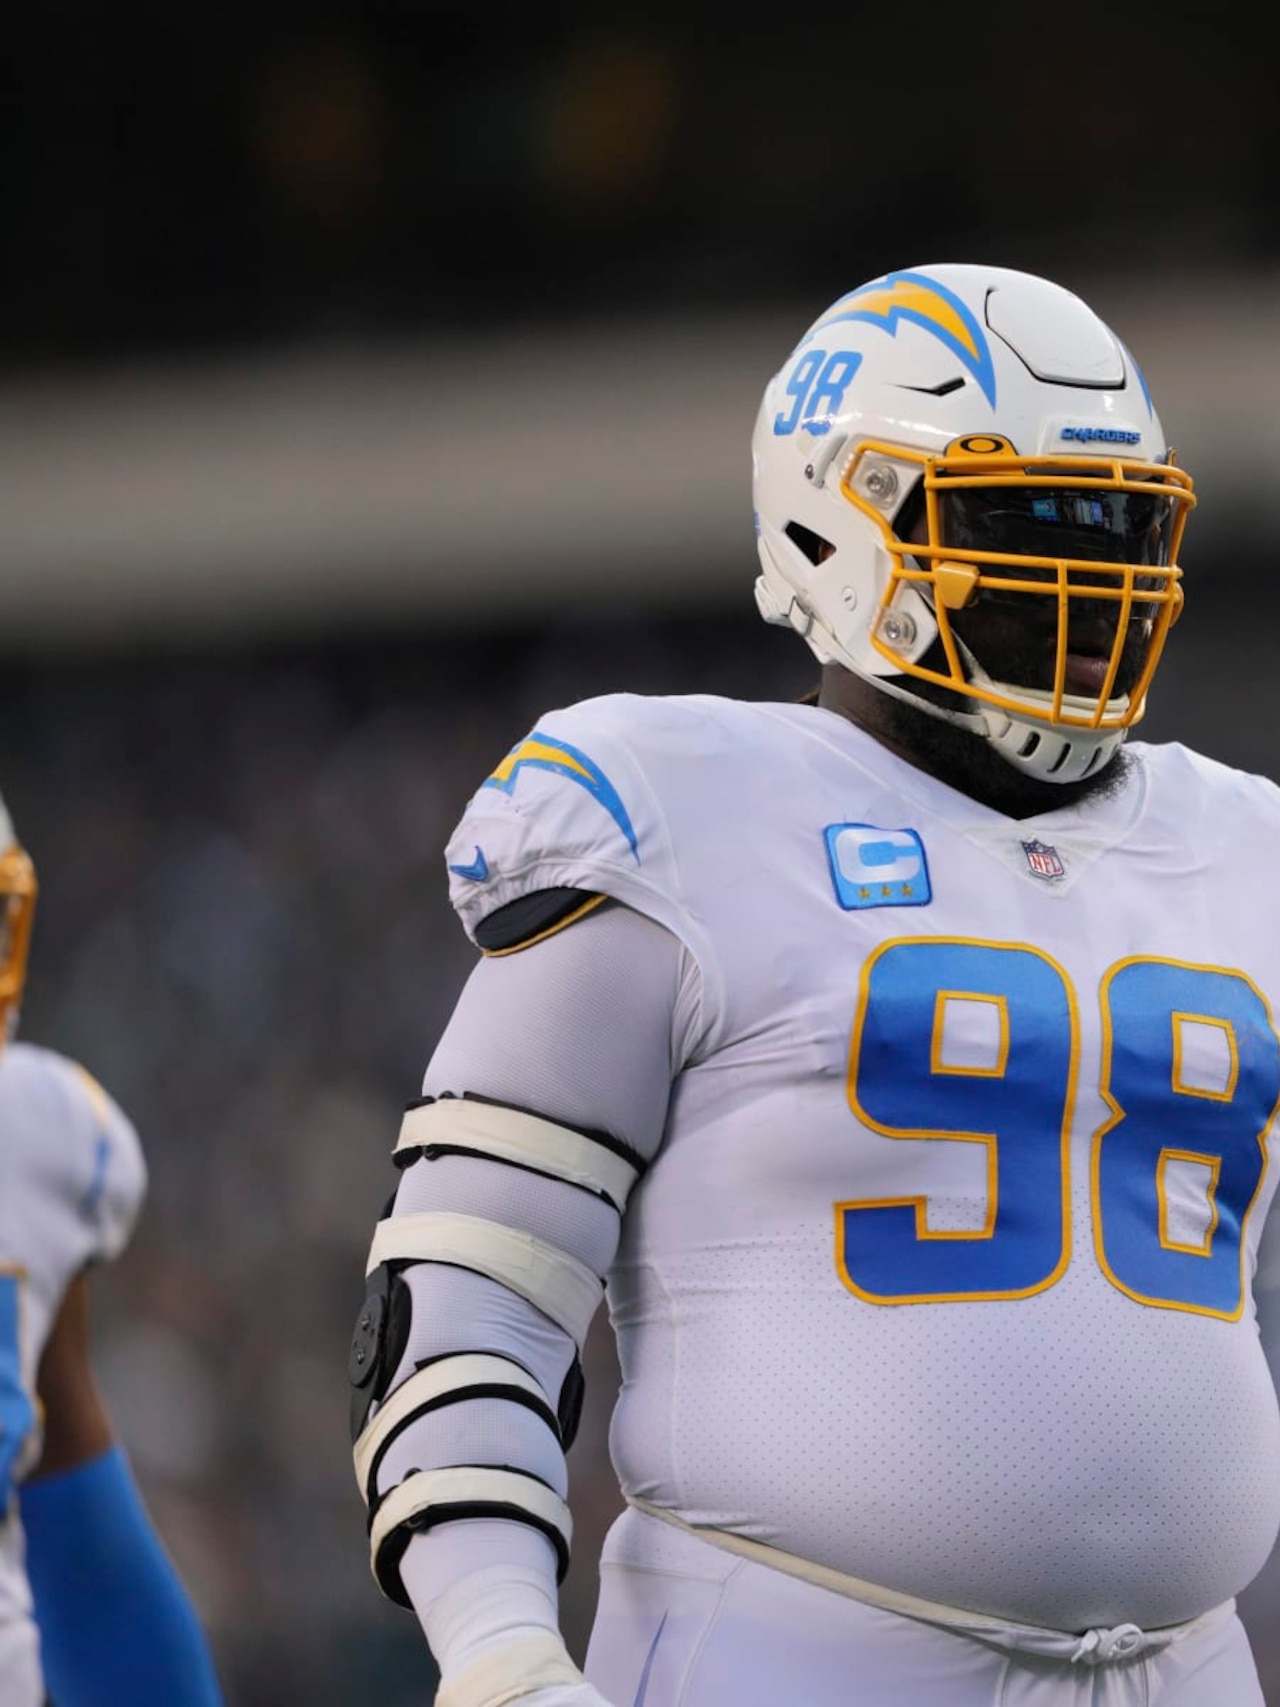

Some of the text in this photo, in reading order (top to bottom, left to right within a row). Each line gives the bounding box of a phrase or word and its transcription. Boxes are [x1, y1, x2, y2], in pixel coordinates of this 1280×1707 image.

[773, 349, 863, 436] 98
[1060, 427, 1141, 445] CHARGERS
[835, 828, 920, 884] C
[1029, 852, 1062, 874] NFL
